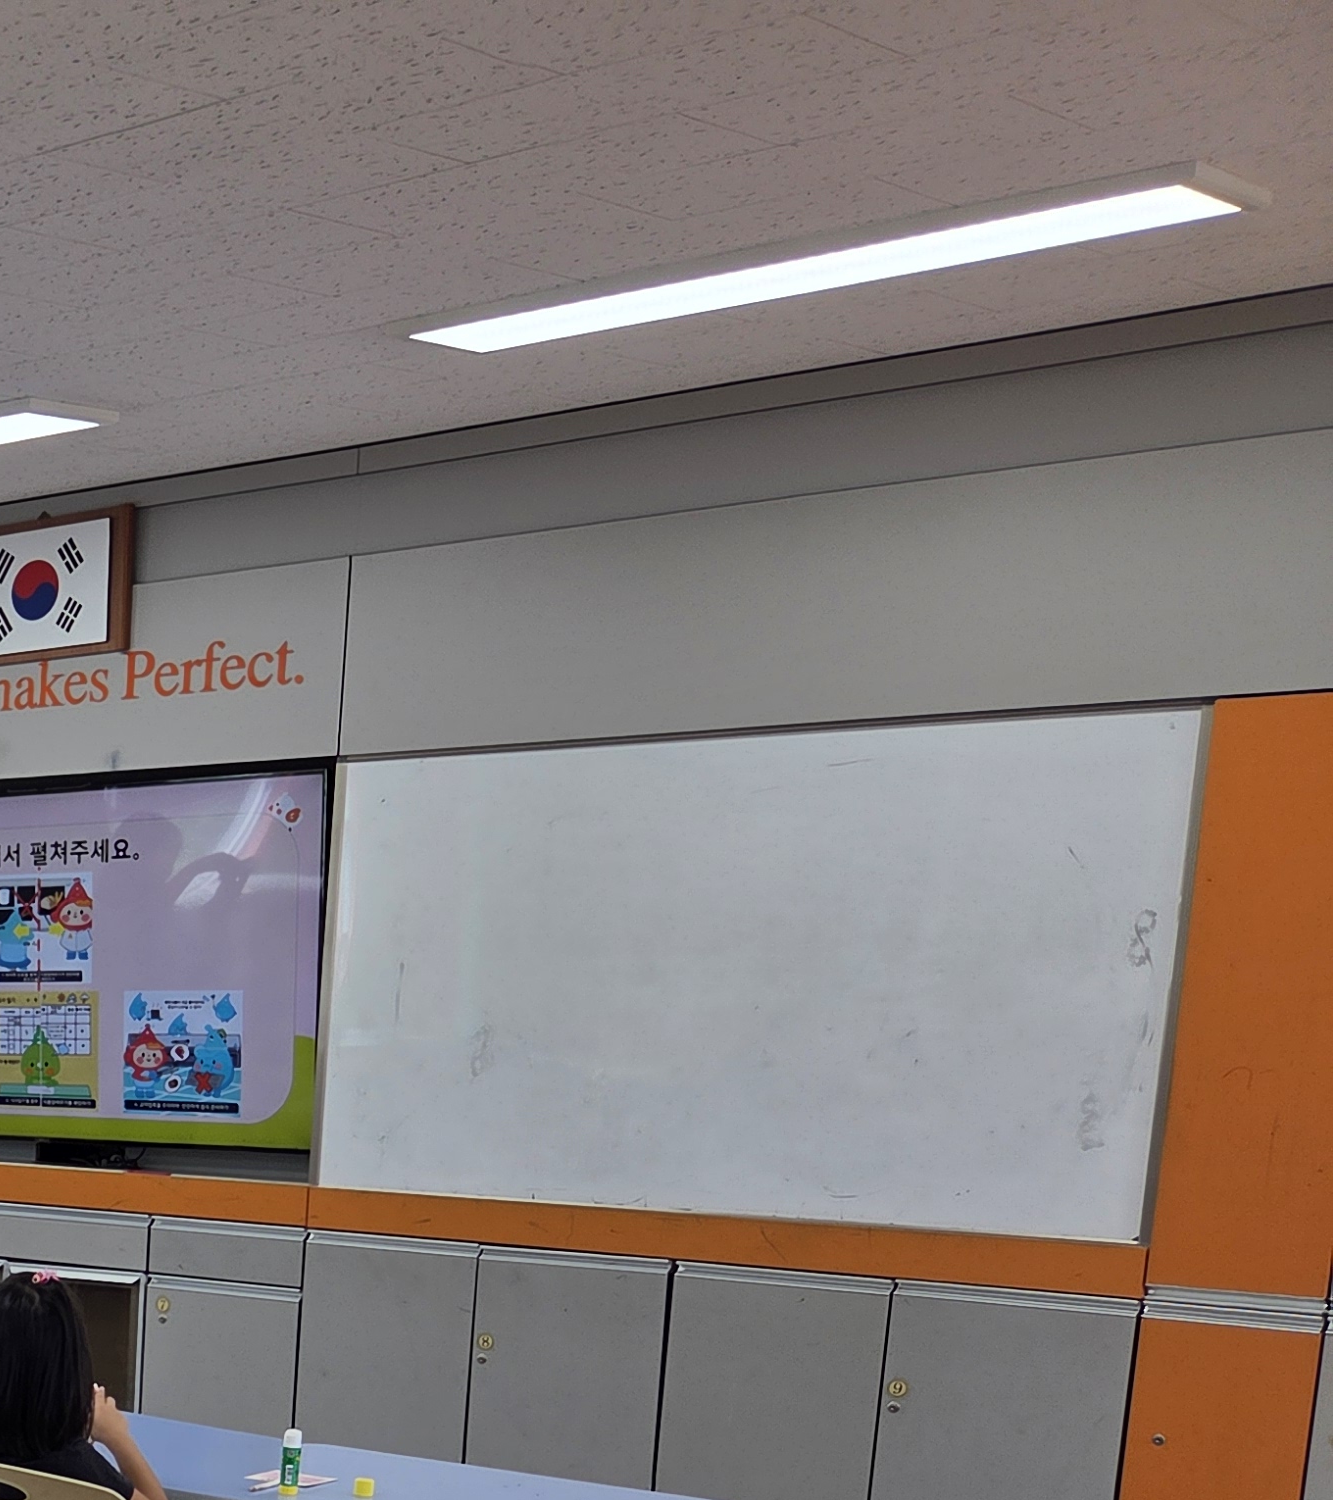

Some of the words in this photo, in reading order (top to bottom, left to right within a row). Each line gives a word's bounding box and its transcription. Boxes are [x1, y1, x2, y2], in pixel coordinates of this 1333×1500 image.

[122, 640, 304, 701] Perfect.
[30, 838, 139, 866] 펼쳐주세요.
[893, 1382, 903, 1394] 9
